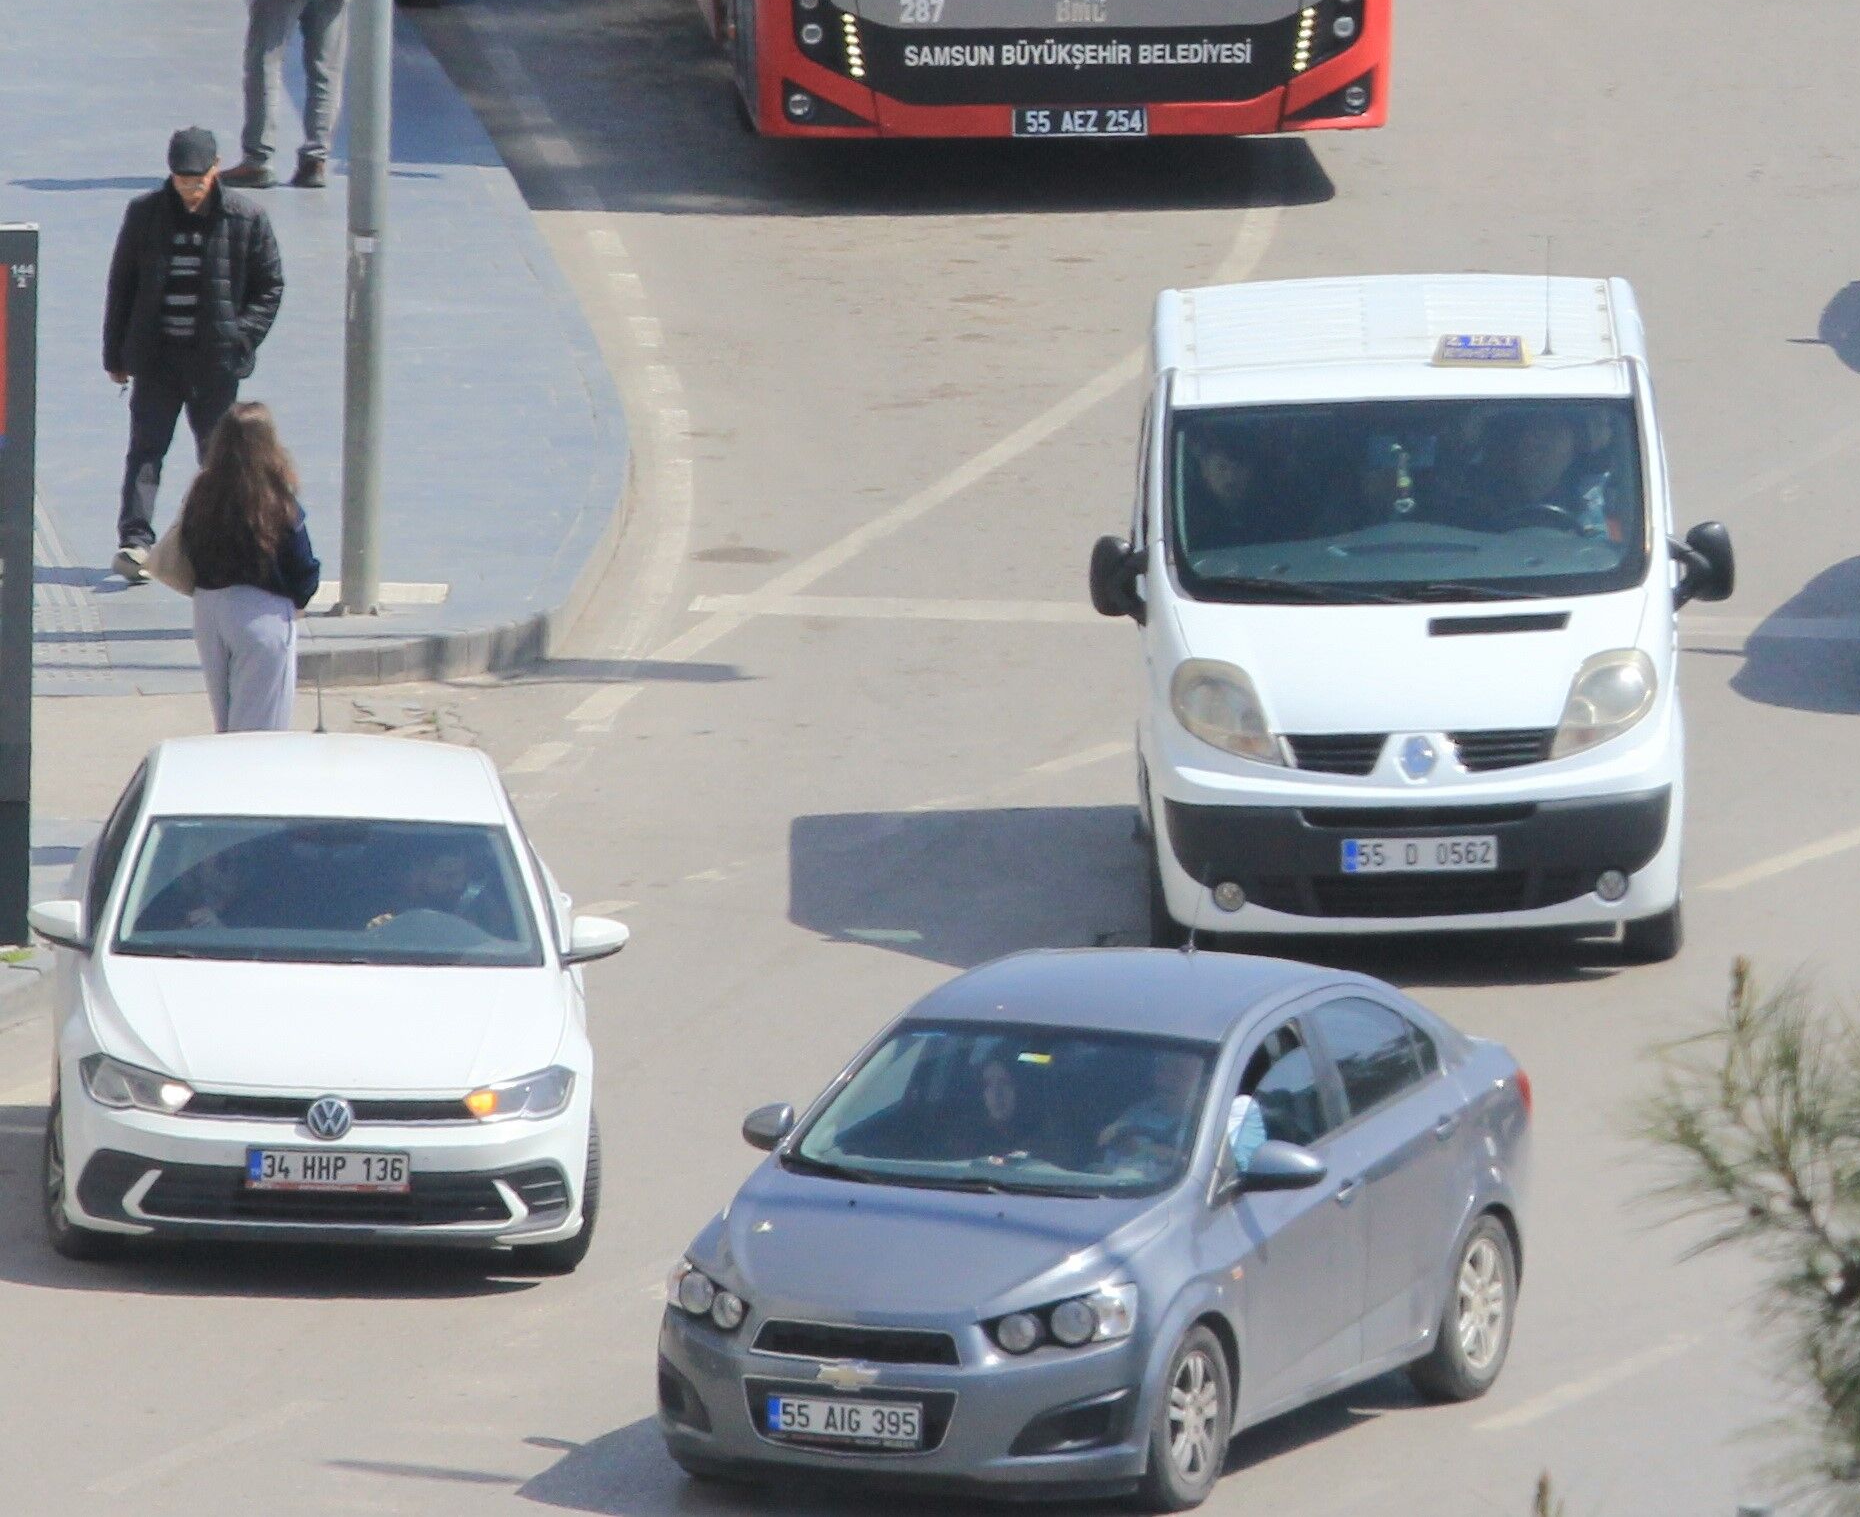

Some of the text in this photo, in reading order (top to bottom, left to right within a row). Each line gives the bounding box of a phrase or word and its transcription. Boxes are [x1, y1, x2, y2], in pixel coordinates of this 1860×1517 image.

[904, 37, 1252, 70] SAMSUN BÜYÜKŞEHİR BELEDİYESİ
[1025, 109, 1142, 133] 55 AEZ 254
[1358, 842, 1385, 867] 55
[1436, 840, 1491, 865] 0562
[263, 1154, 404, 1182] 34 HHP 136
[781, 1402, 916, 1436] 55 AIG 395
